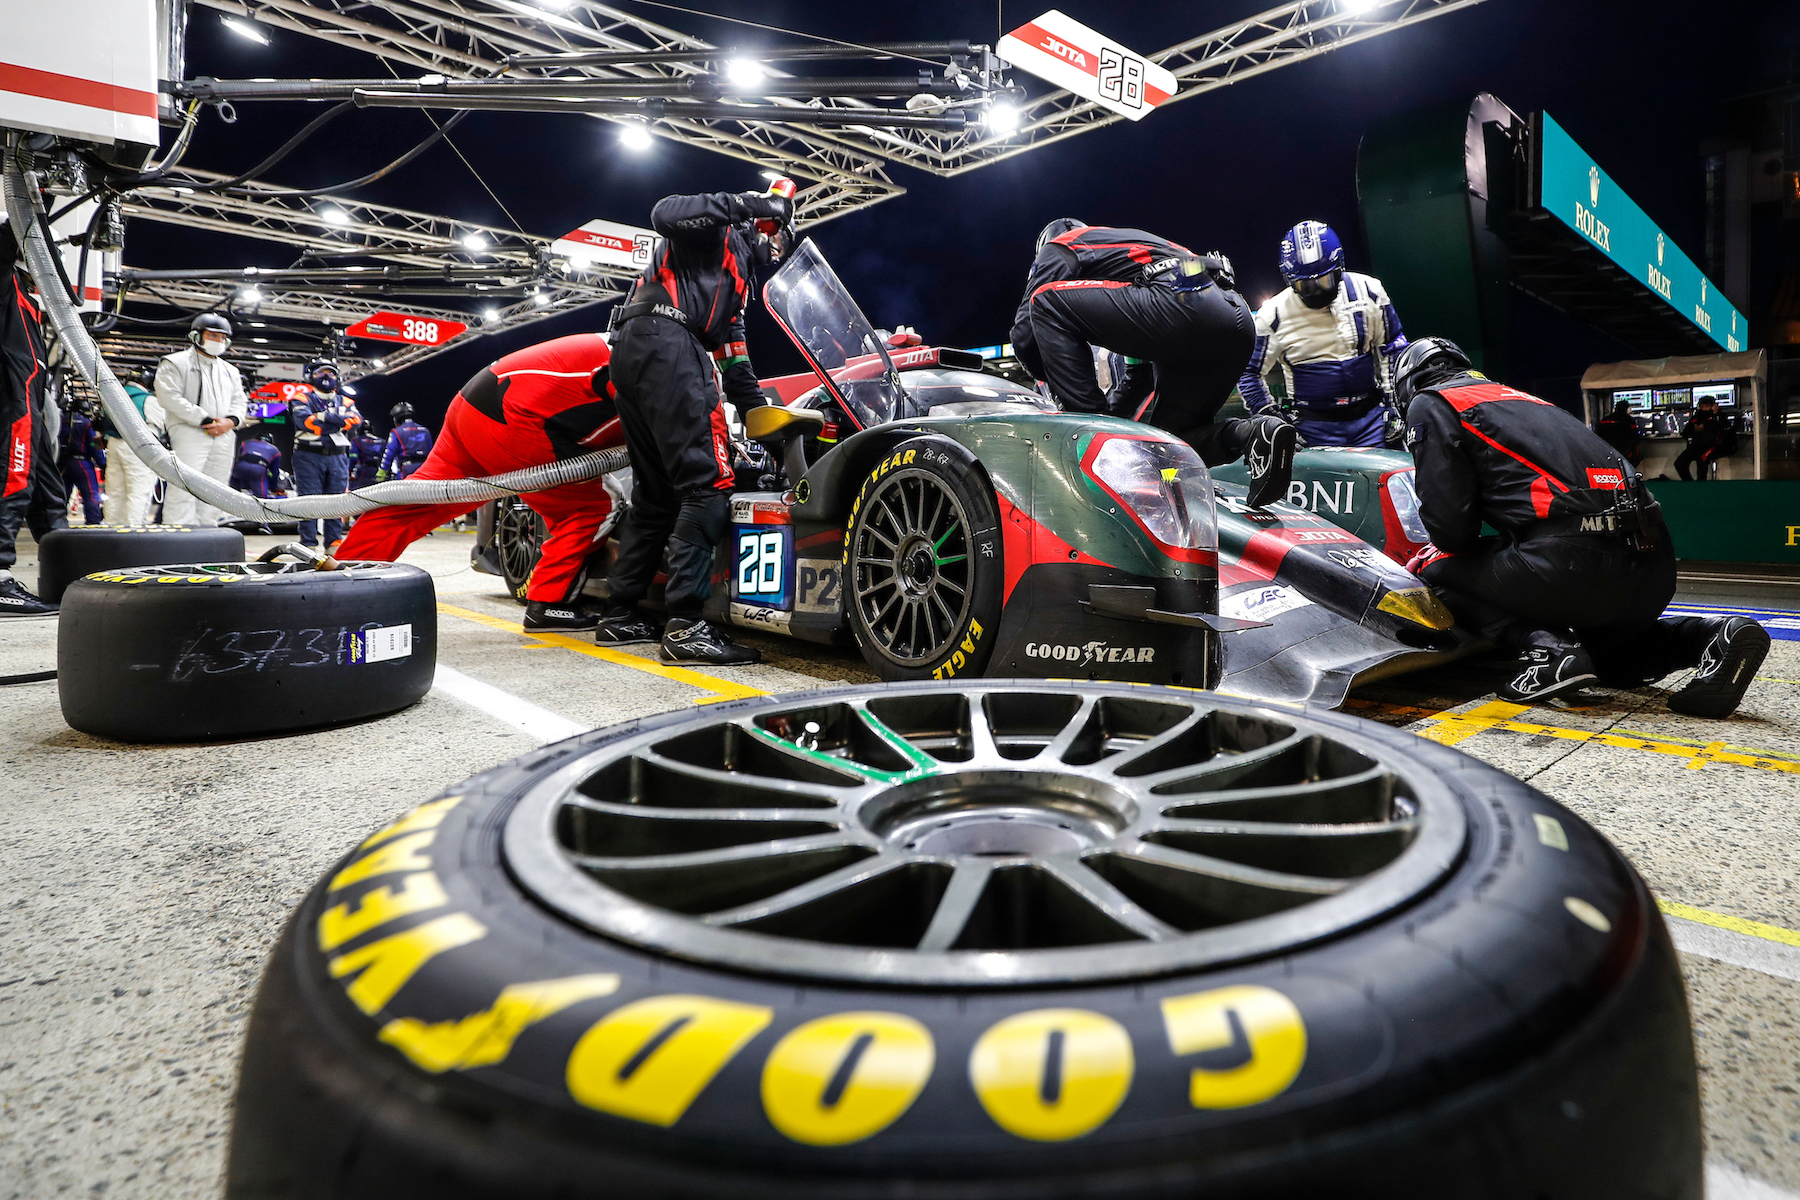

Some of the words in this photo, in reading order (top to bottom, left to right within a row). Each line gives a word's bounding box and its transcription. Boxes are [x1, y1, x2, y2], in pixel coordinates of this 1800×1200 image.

[1040, 36, 1086, 68] JOTA
[1098, 47, 1145, 109] 28
[584, 234, 623, 249] JOTA
[1575, 201, 1611, 252] ROLEX
[1648, 263, 1672, 300] ROLEX
[402, 319, 438, 343] 388
[1695, 304, 1711, 333] ROLEX
[900, 350, 934, 366] JOTA
[14, 437, 26, 473] JOTA
[1285, 480, 1356, 515] BNI
[980, 541, 994, 558] RF
[1293, 531, 1350, 541] JOTA
[737, 531, 785, 595] 28
[799, 566, 838, 606] P2
[1243, 589, 1287, 610] WEC
[543, 608, 576, 618] sparco
[743, 607, 775, 623] WEC
[932, 616, 985, 680] EAGLE
